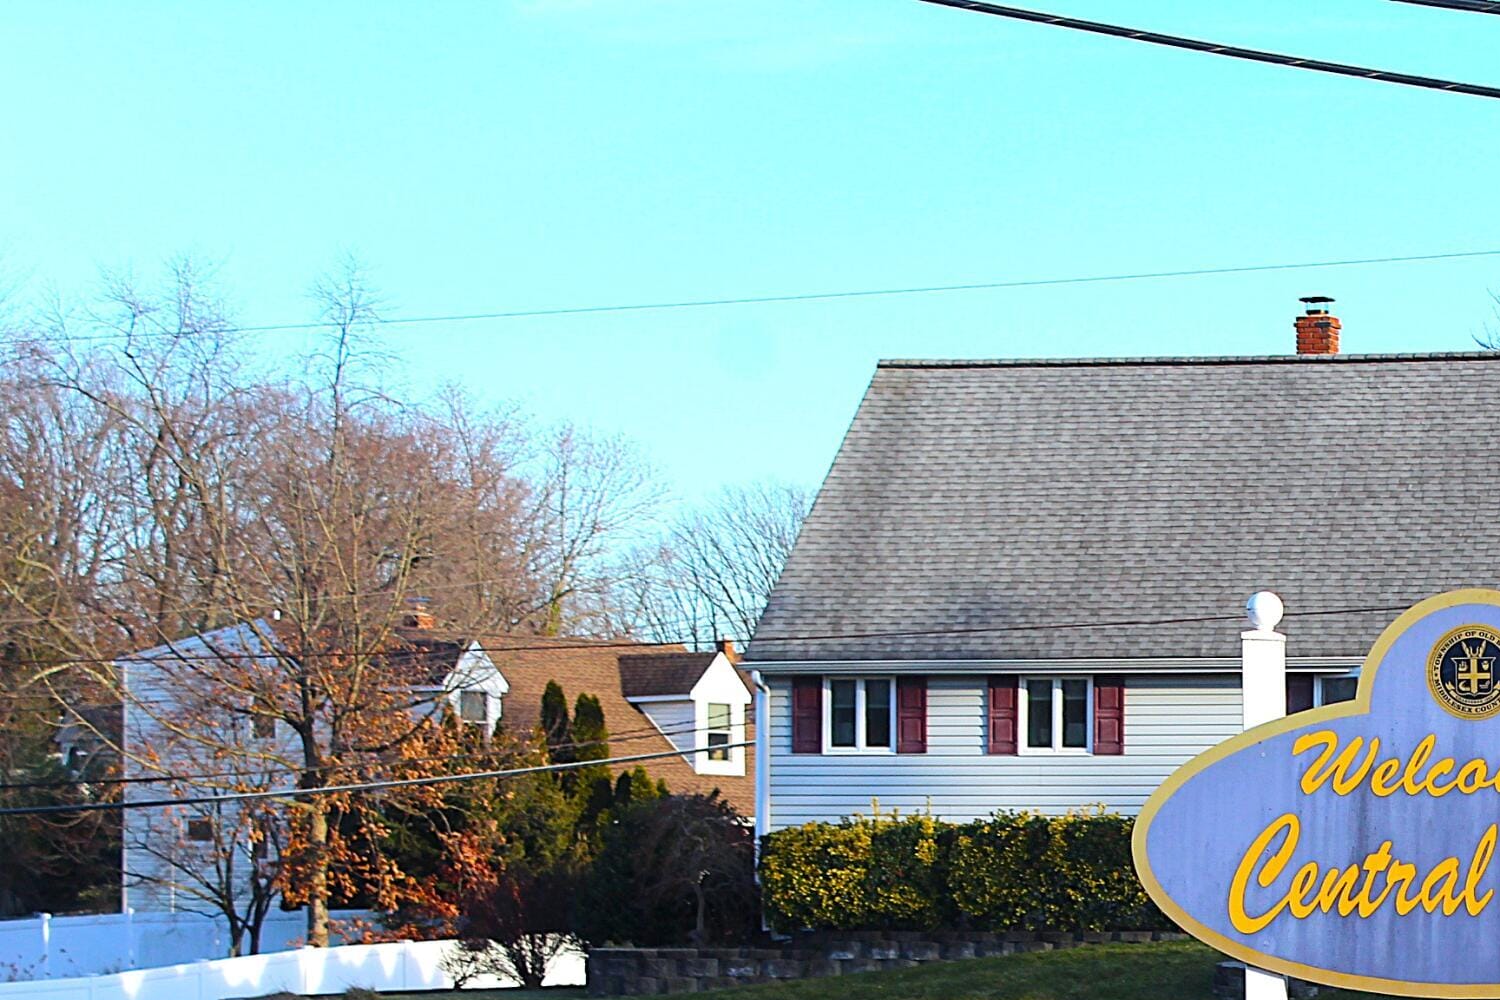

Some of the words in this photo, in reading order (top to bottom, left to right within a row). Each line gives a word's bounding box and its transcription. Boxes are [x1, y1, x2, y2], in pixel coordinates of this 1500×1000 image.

[1433, 633, 1463, 671] TOWNSHIP
[1478, 631, 1496, 642] OLD
[1433, 678, 1473, 713] MIDDLESEX
[1229, 812, 1498, 935] Central
